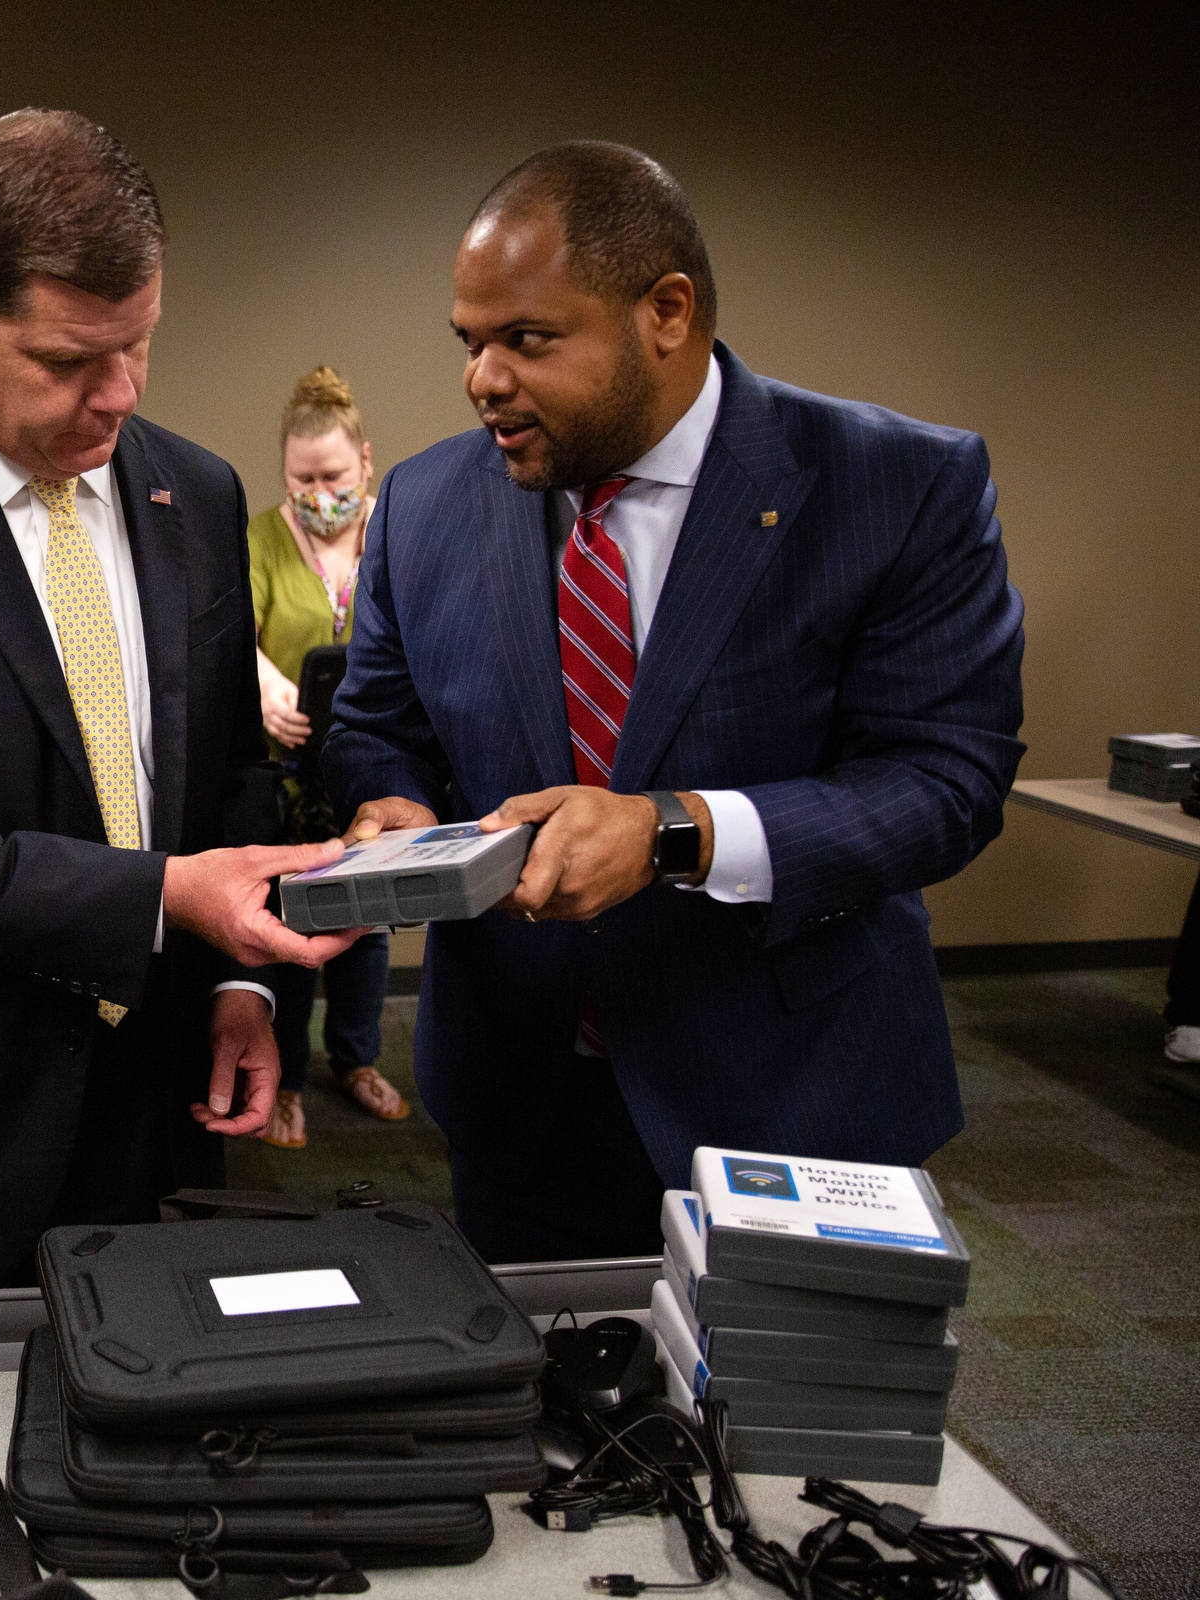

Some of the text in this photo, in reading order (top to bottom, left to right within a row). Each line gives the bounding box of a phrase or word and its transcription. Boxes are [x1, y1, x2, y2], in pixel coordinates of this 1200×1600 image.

[798, 1166, 892, 1182] Hotspot
[808, 1176, 888, 1191] Mobile
[825, 1187, 878, 1199] WiFi
[815, 1195, 897, 1211] Device
